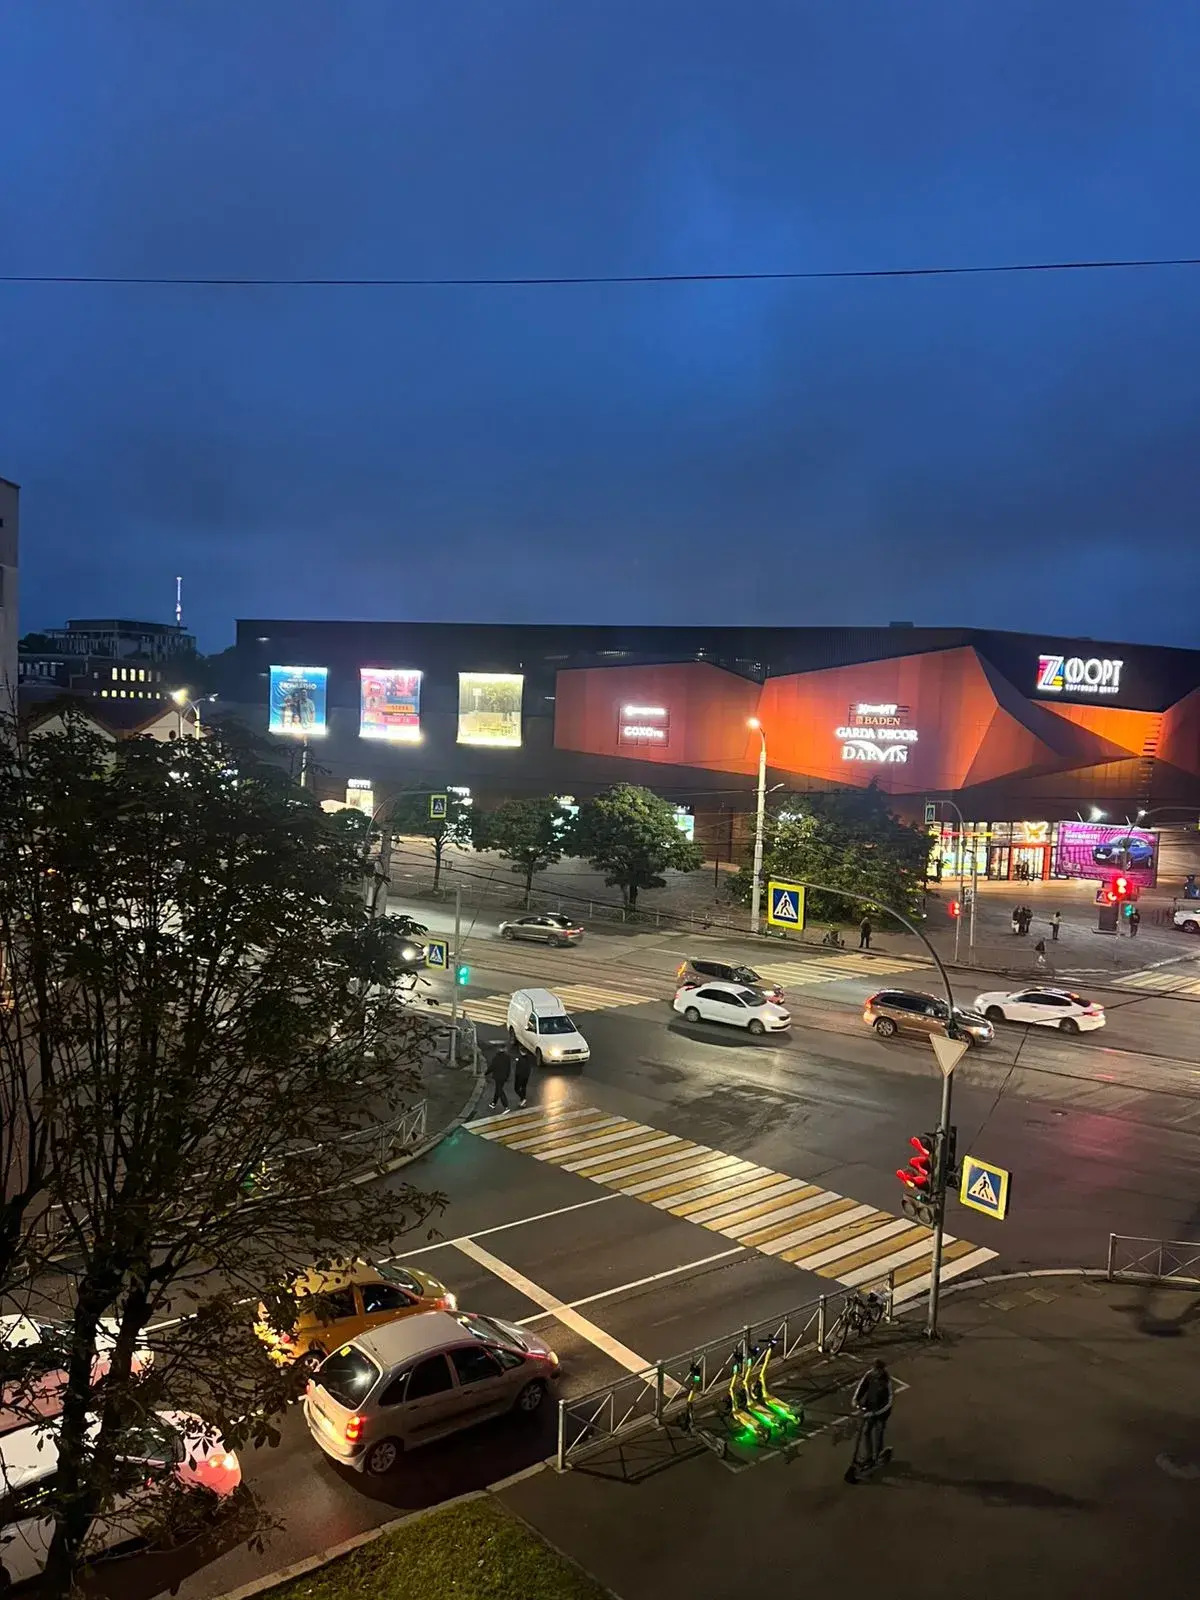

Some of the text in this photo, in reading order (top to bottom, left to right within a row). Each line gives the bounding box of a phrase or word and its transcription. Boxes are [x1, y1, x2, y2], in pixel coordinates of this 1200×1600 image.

[864, 716, 901, 726] BADEN
[836, 727, 919, 741] GARDA DECOR
[842, 740, 909, 763] DARVIN
